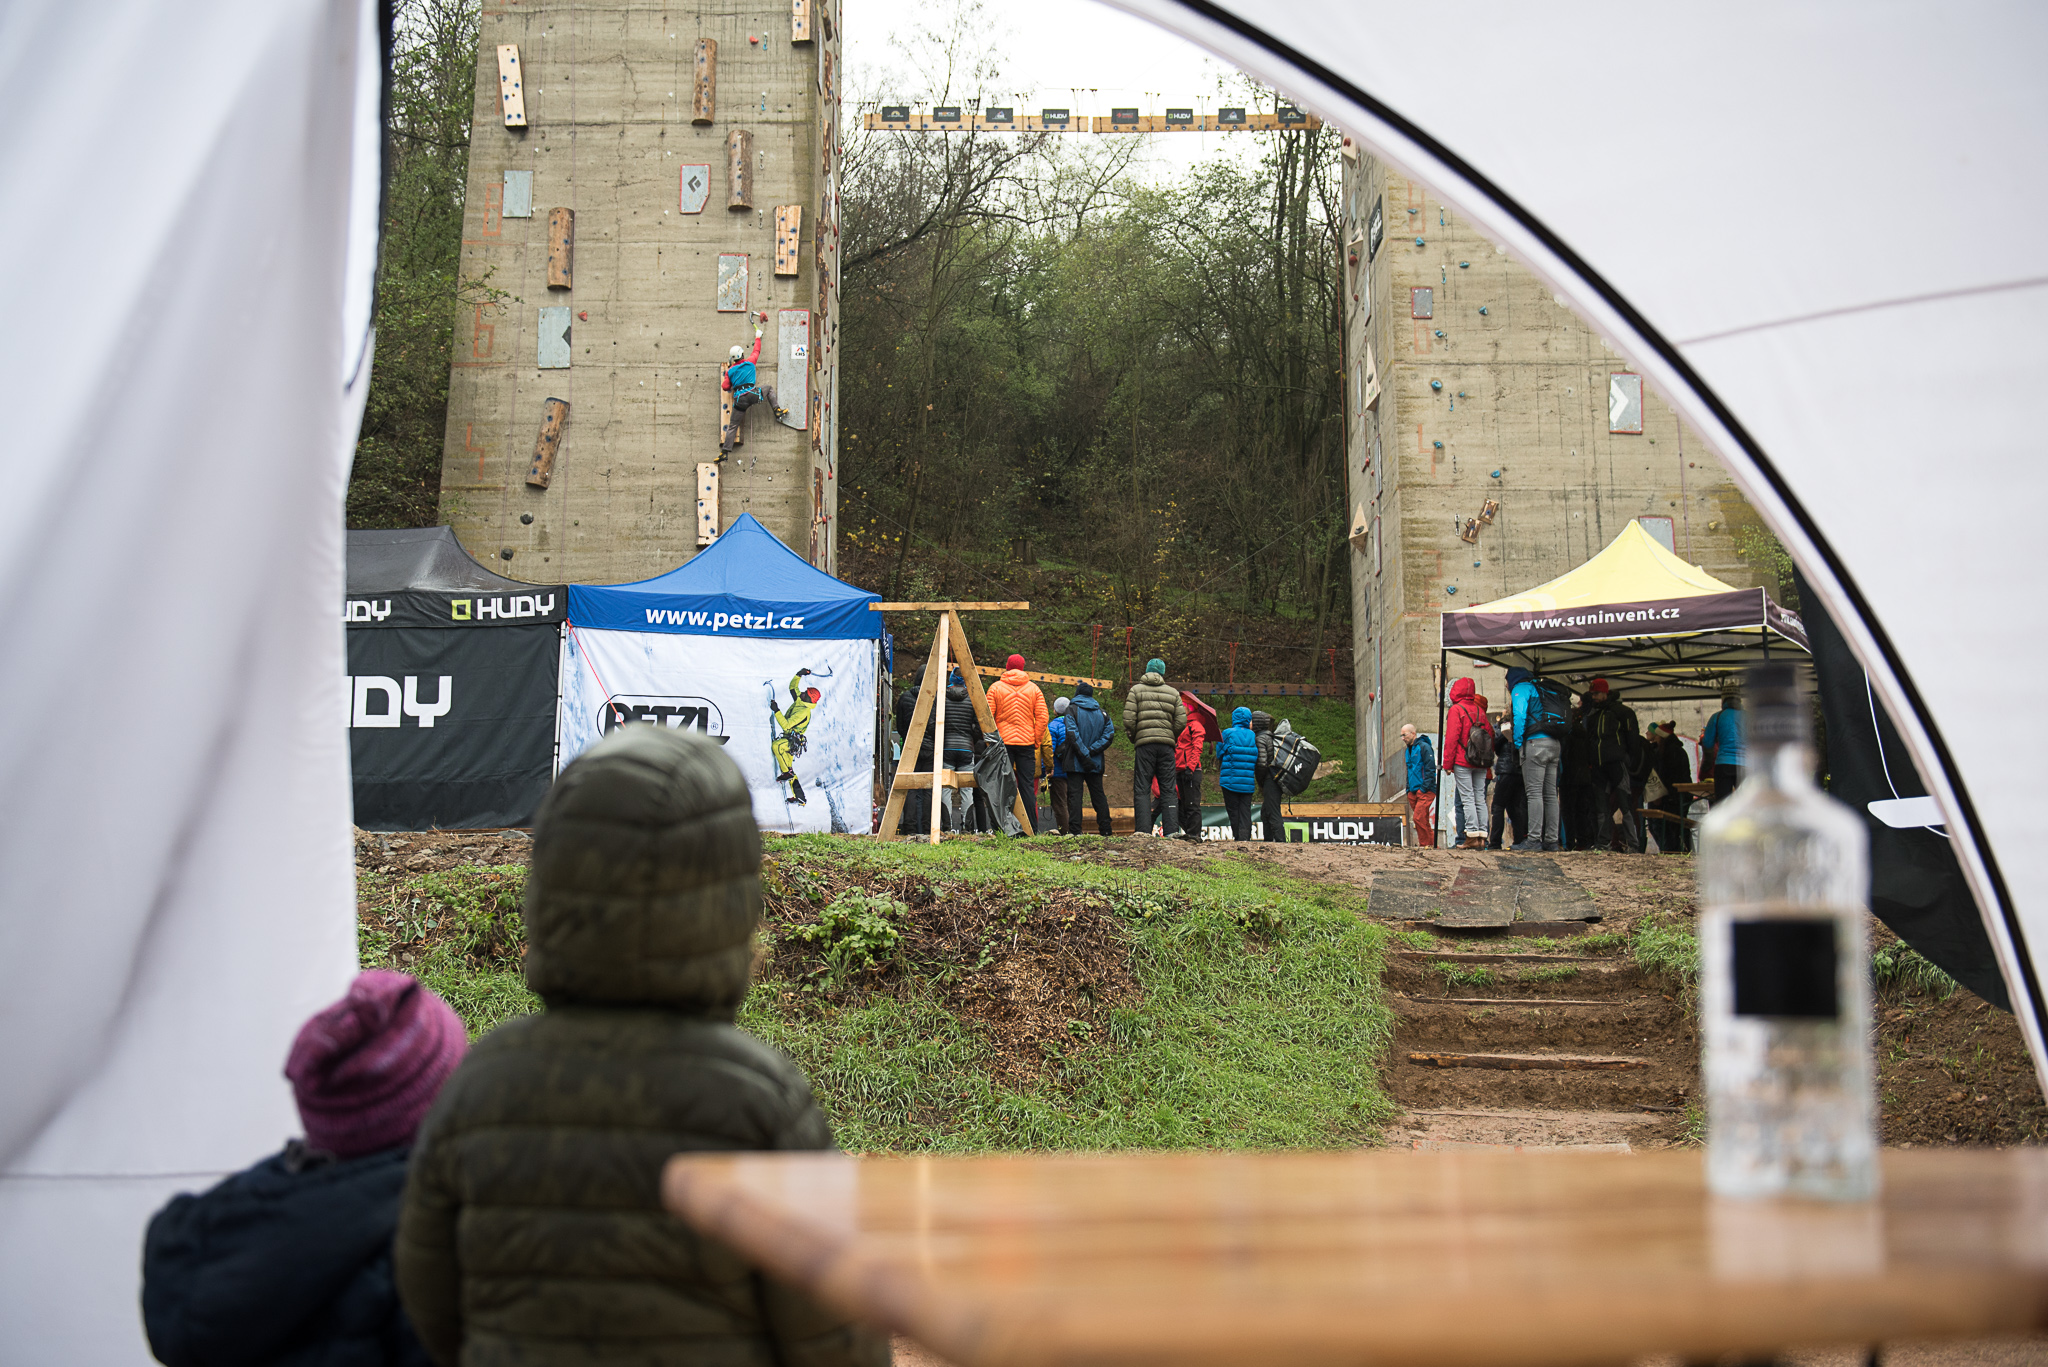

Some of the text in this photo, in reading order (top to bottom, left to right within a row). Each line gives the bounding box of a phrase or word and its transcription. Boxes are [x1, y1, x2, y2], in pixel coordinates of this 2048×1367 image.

[341, 600, 391, 622] DY
[477, 593, 555, 620] HUDY
[645, 608, 805, 632] www.petzl.cz
[1519, 608, 1680, 631] www.suninvent.cz
[345, 675, 453, 728] DY
[1312, 821, 1374, 840] HUDY
